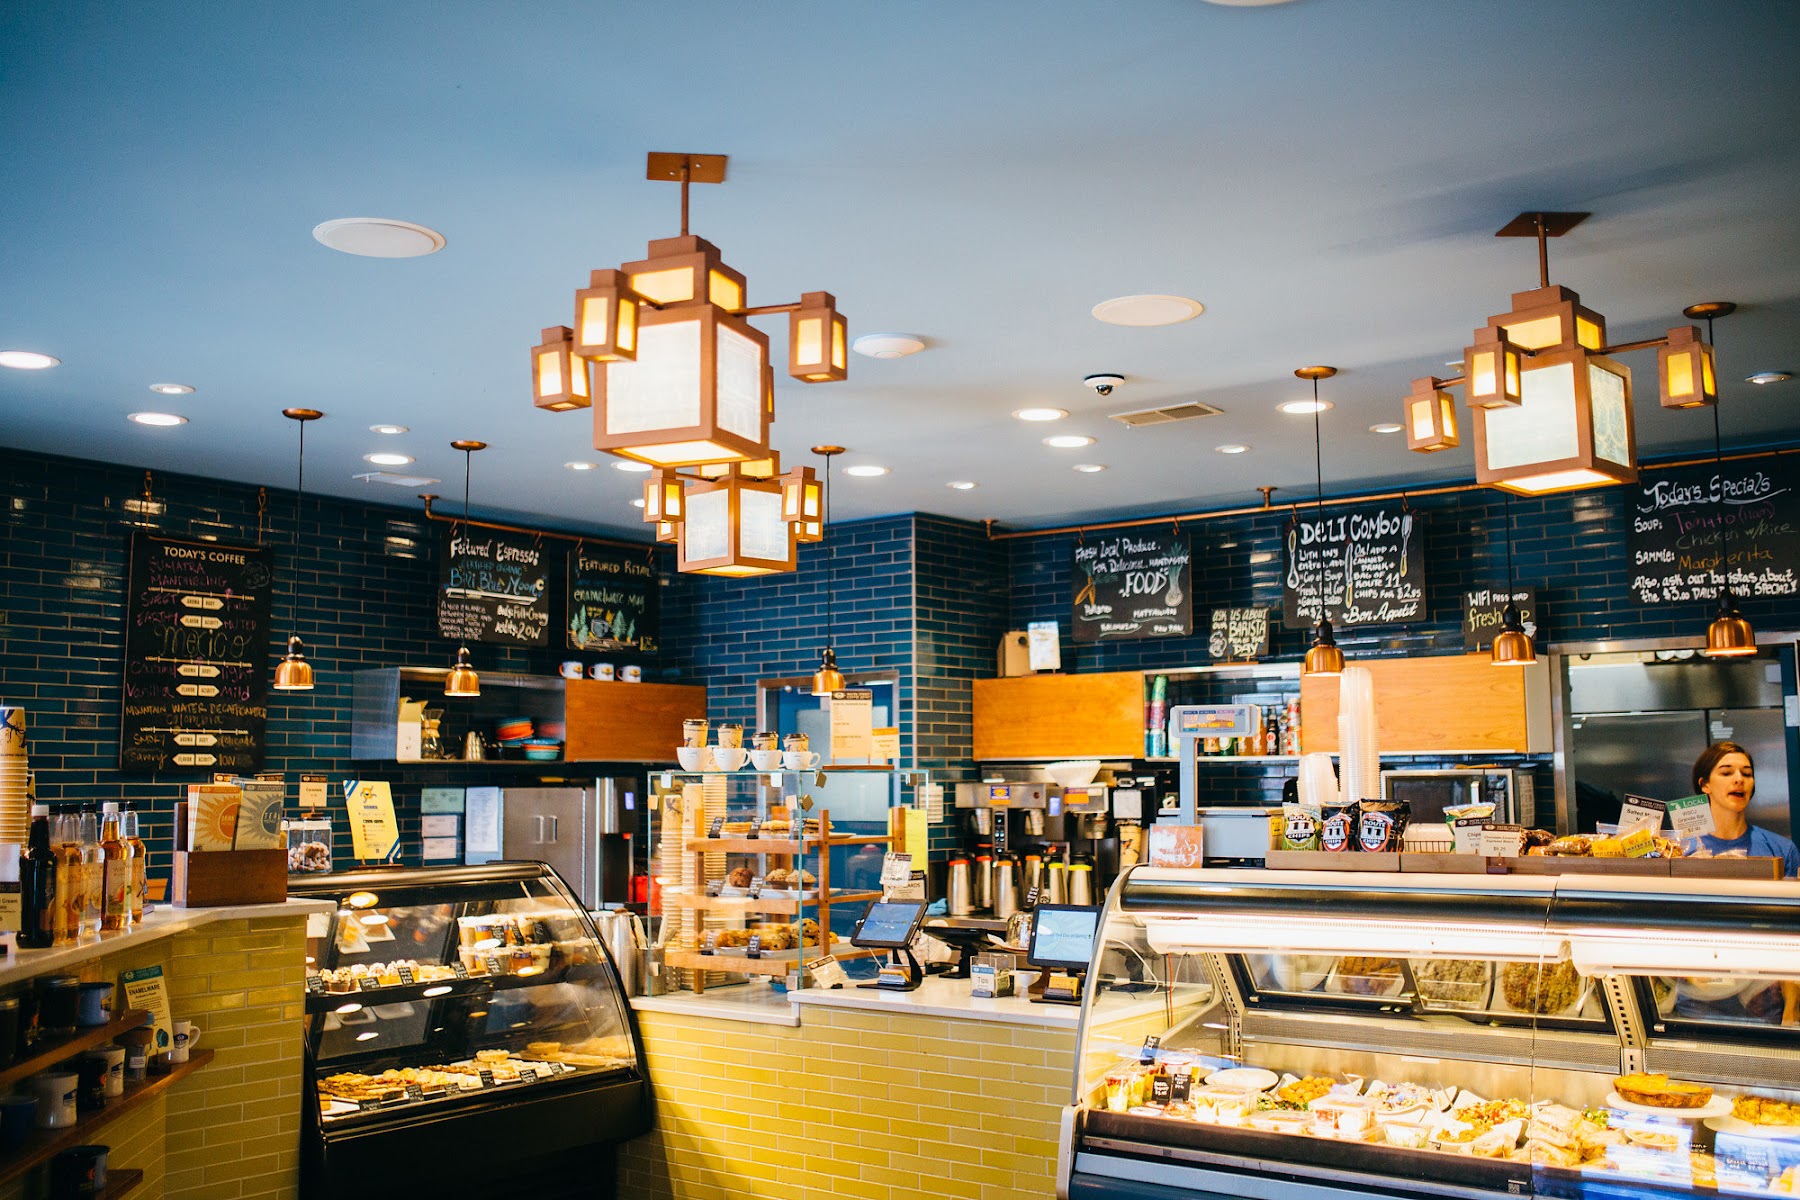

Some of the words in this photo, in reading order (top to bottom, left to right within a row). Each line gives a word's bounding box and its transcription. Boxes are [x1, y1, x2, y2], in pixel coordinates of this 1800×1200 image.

[1709, 472, 1770, 503] Specials
[1300, 515, 1347, 545] DELI
[163, 546, 206, 561] TODAY'S
[208, 551, 246, 566] COFFEE
[578, 556, 620, 574] FEATURED
[479, 570, 502, 592] Blue
[1125, 571, 1168, 595] FOOD
[1385, 572, 1402, 588] 11
[1662, 573, 1685, 587] ask
[1687, 573, 1708, 585] our
[1709, 567, 1758, 585] baistas
[1759, 567, 1793, 583] about
[1468, 589, 1490, 607] WIFI
[1640, 588, 1660, 603] the
[1230, 608, 1241, 621] US
[1229, 619, 1266, 638] BARISTA
[1233, 642, 1259, 657] DAY
[1367, 828, 1381, 836] 11
